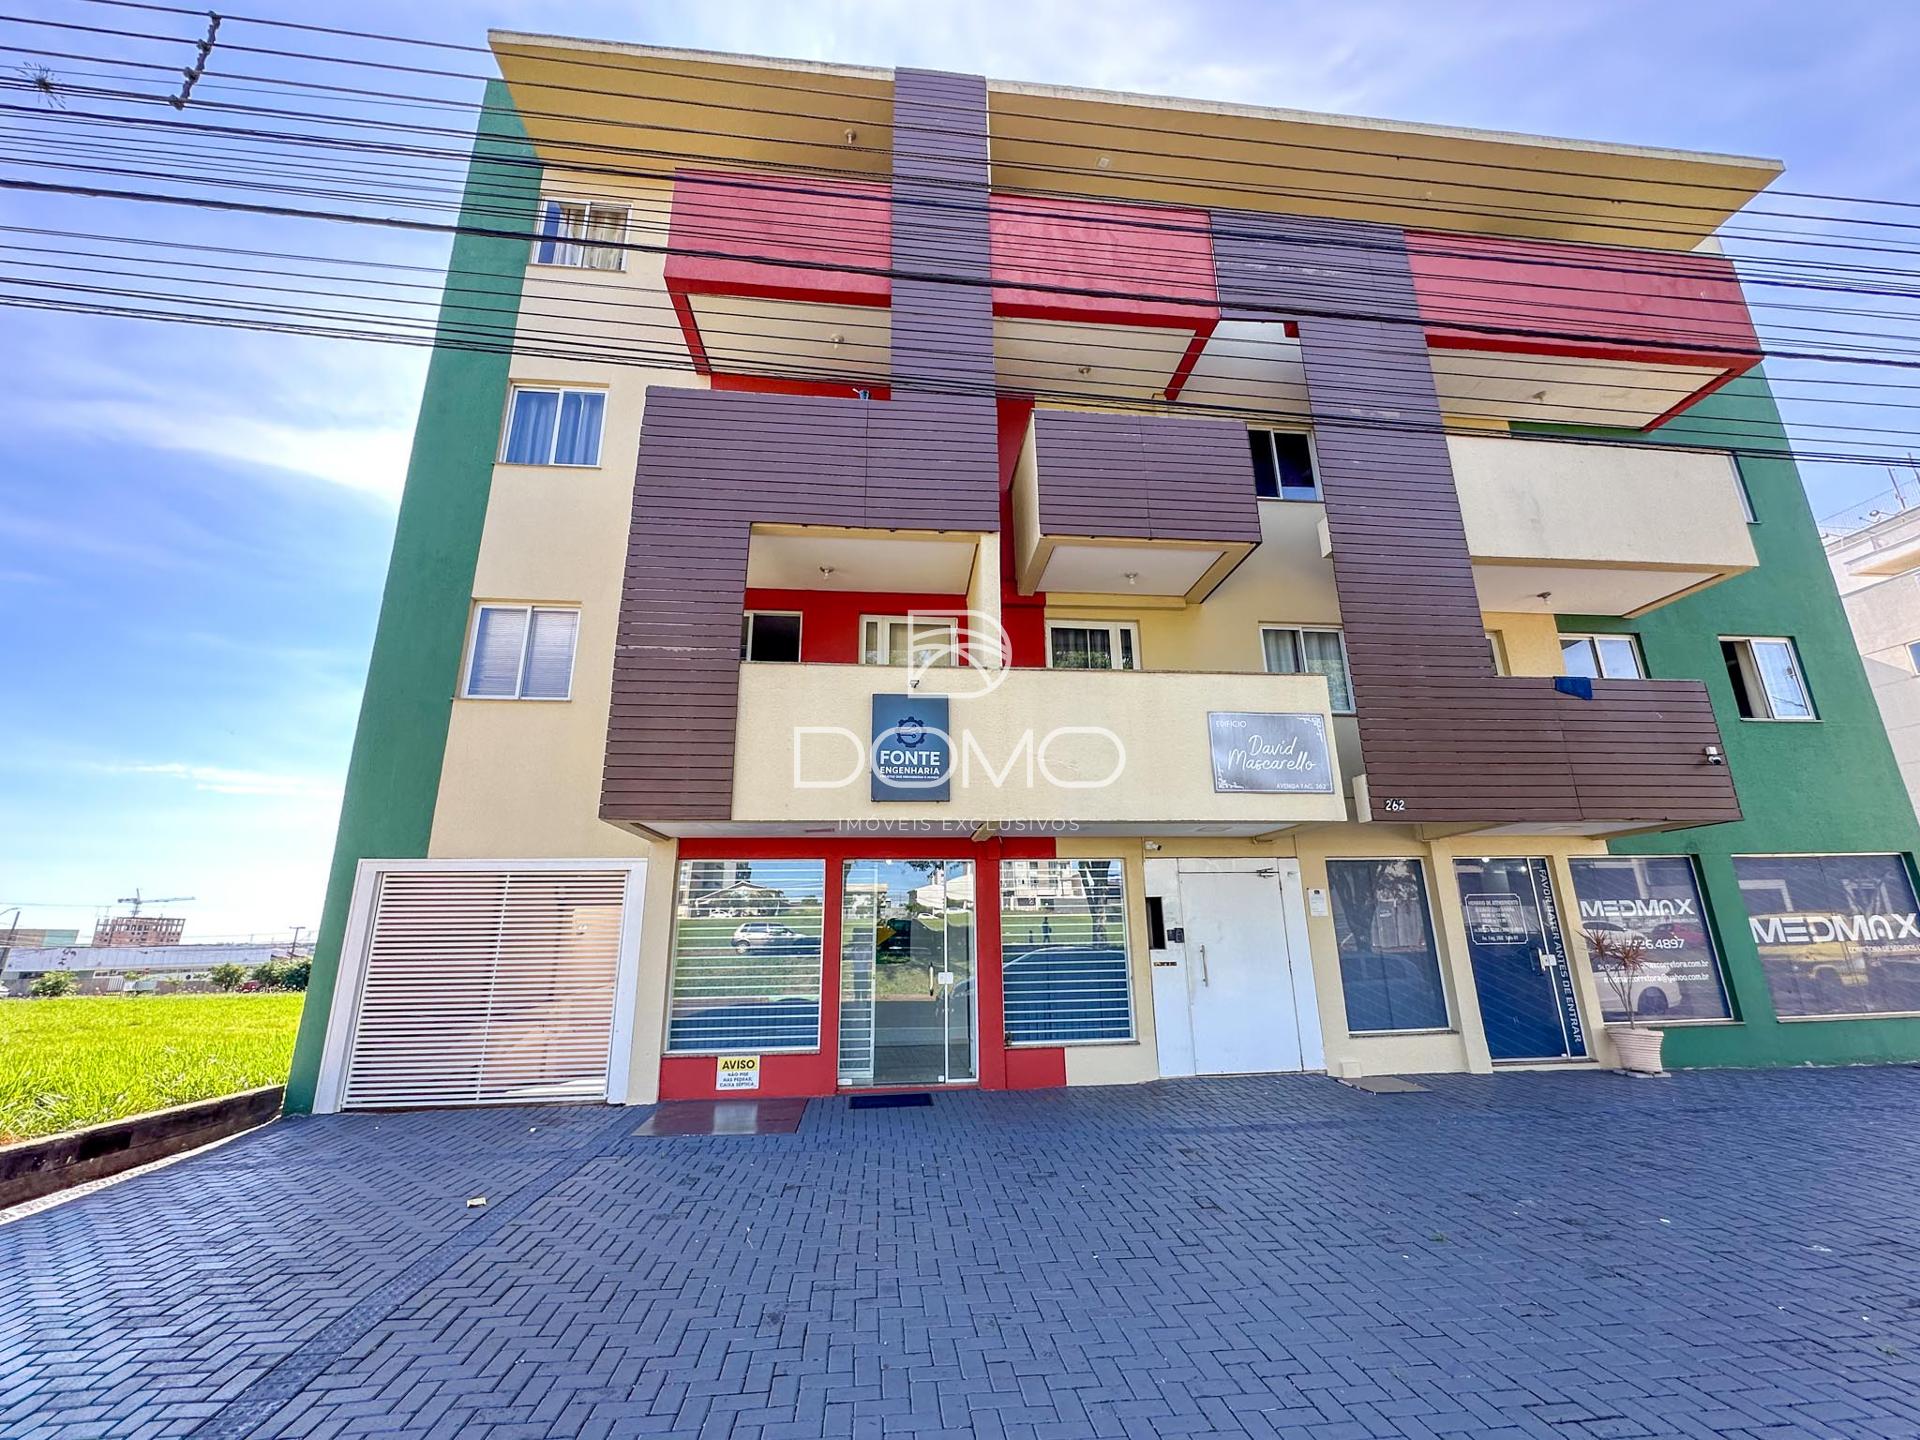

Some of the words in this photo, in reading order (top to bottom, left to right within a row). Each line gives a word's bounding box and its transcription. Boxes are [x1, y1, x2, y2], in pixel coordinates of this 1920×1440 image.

[1248, 734, 1298, 756] David
[880, 750, 940, 766] FONTE
[1227, 749, 1317, 773] Mascarello
[880, 766, 940, 775] ENGENHARIA
[1385, 799, 1405, 811] 262
[1539, 869, 1553, 903] FAVOR
[1580, 899, 1695, 917] MEDMAX
[1749, 913, 1920, 943] MEDMAX
[1554, 941, 1569, 978] ANTES
[1562, 980, 1572, 995] DE
[1566, 996, 1582, 1043] ENTRAR
[722, 1060, 755, 1069] AVISO
